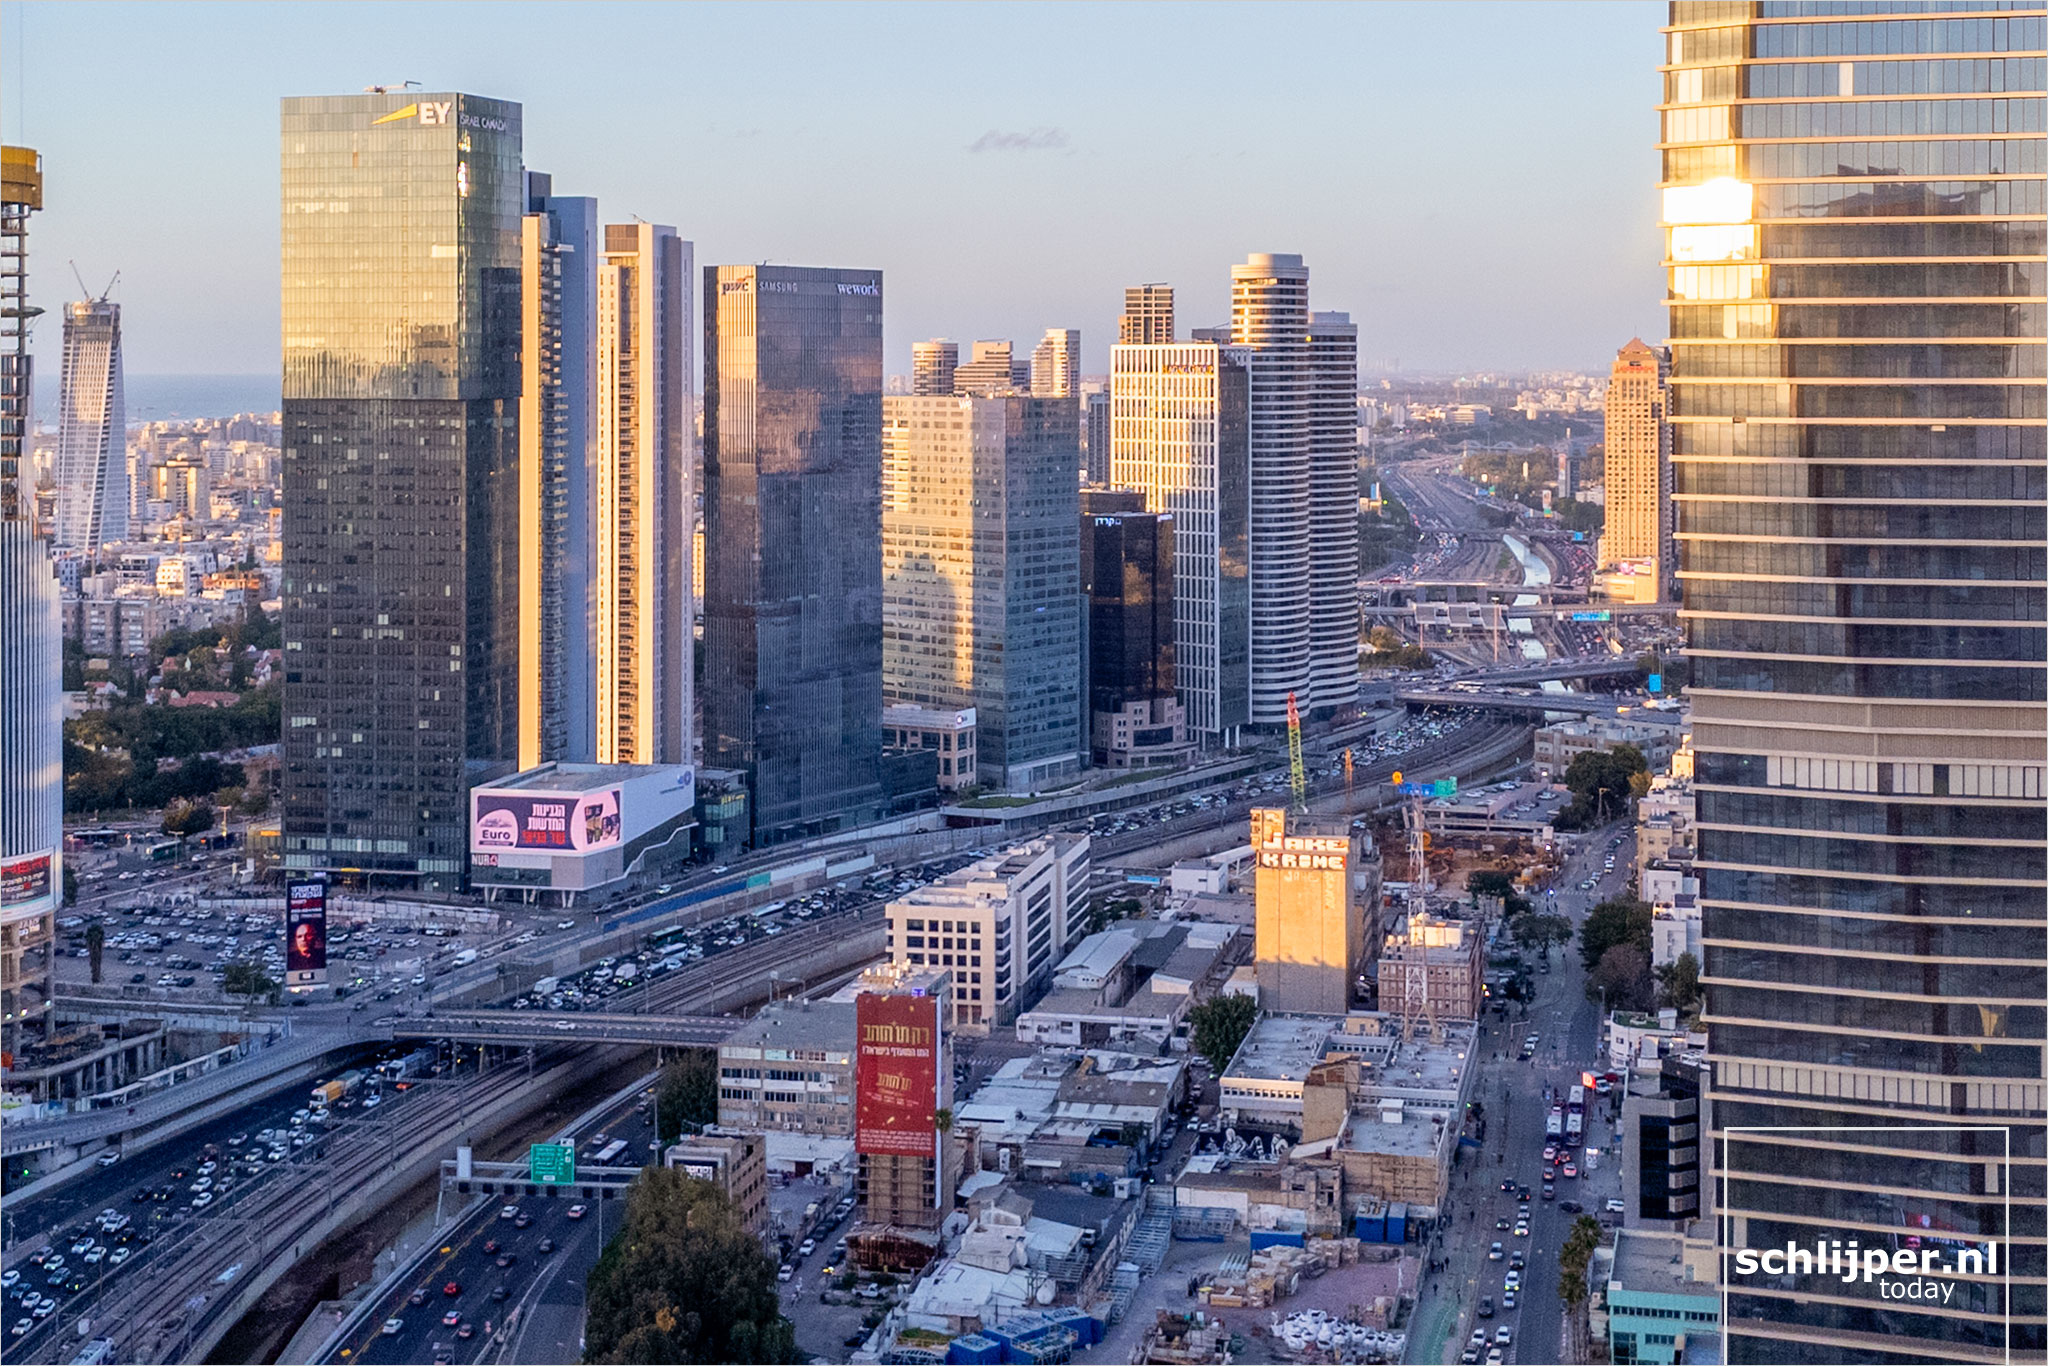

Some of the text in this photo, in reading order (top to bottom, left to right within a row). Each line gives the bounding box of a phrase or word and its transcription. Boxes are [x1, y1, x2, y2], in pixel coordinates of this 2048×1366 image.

[419, 102, 452, 124] EY
[459, 112, 480, 127] ISRAEL
[722, 281, 749, 295] pwc
[759, 281, 798, 293] SAMSUNG
[532, 803, 566, 817] הגבינות
[527, 817, 566, 831] החדשות
[482, 829, 511, 840] Euro
